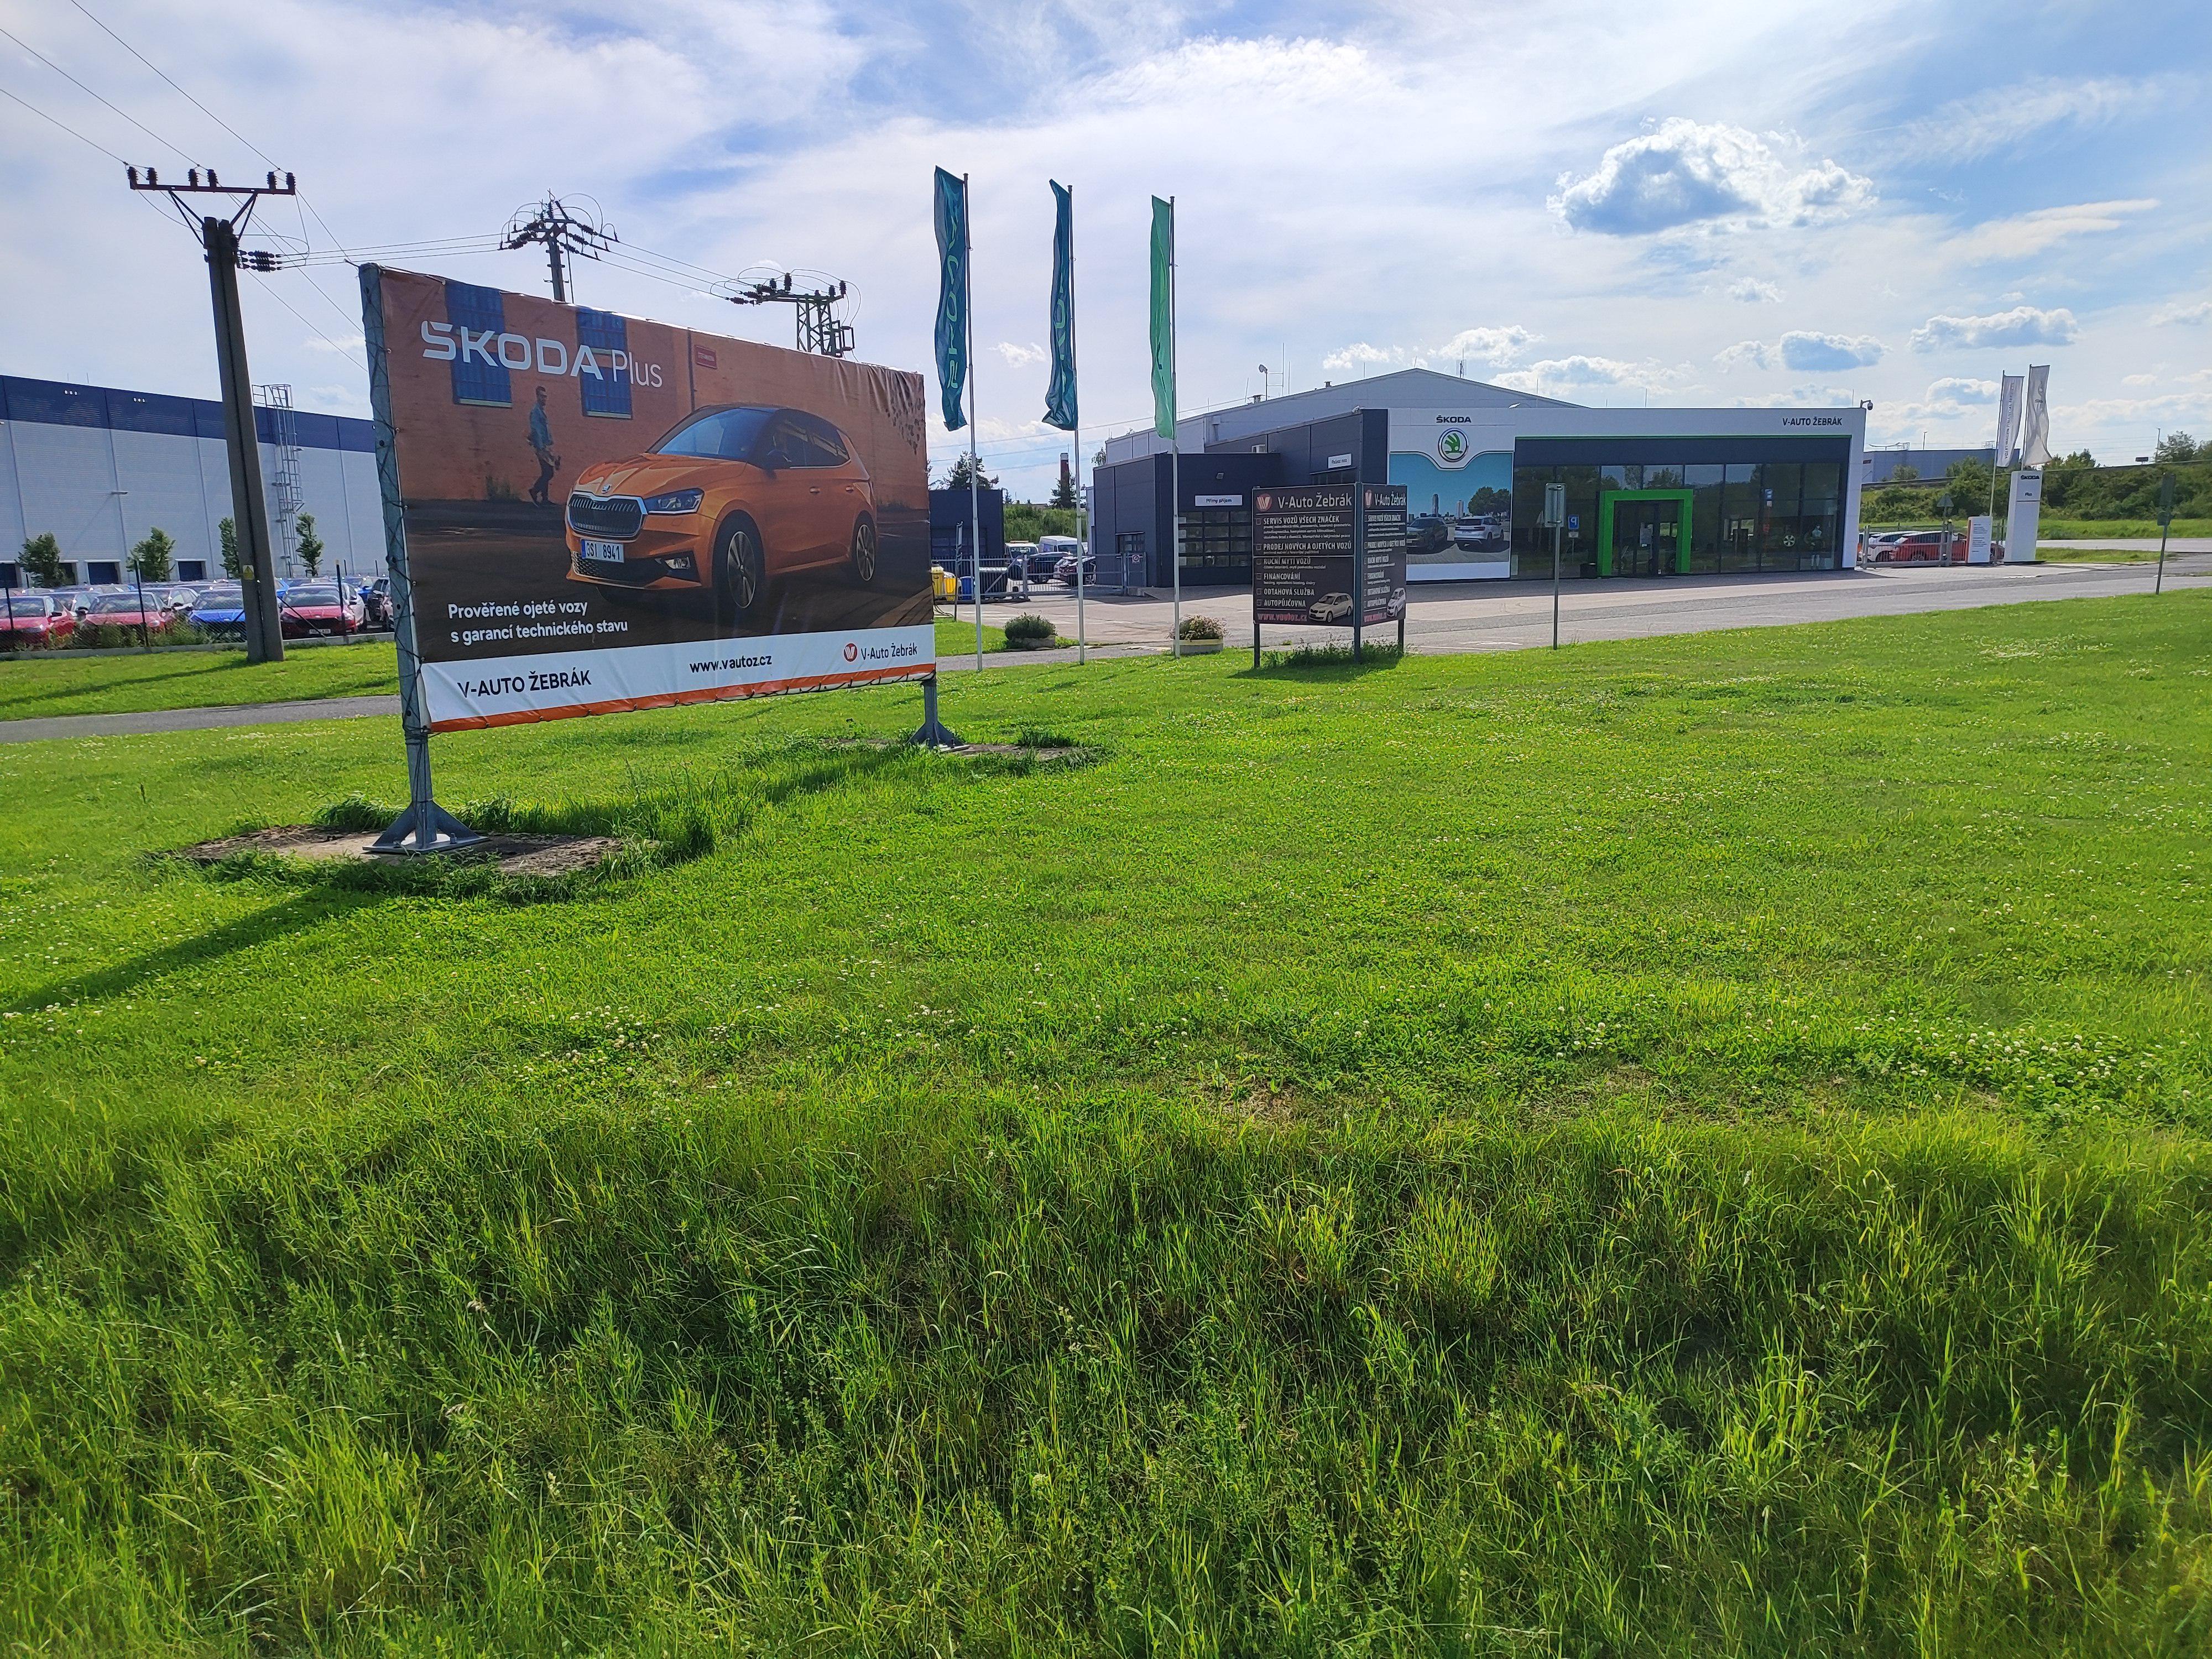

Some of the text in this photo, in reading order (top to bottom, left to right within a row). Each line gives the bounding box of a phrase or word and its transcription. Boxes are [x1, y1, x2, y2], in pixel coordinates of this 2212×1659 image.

[611, 348, 663, 388] Plus
[1436, 415, 1472, 423] ŠKODA
[1782, 416, 1843, 426] V-AUTO ŽEBRÁK
[1277, 492, 1353, 509] V-Auto Žebrák
[1374, 491, 1406, 506] V-Auto Žebrák
[1283, 515, 1298, 524] VOZŮ
[1299, 515, 1317, 524] VŠECH
[1317, 514, 1340, 523] ZNAČEK
[1285, 541, 1306, 550] NOVÝCH
[1312, 541, 1335, 550] OJETÝCH
[1336, 540, 1352, 549] VOZŮ
[1264, 572, 1301, 580] FINANCOVÁNÍ
[1264, 587, 1293, 596] ODTAHOVÁ
[448, 599, 588, 619] Prověřené ojeté vozy
[451, 619, 628, 646] s garancí technického stavu
[891, 643, 918, 658] Žebrák
[689, 655, 773, 673] www.vautoz.cz
[457, 667, 593, 698] V-AUTO ŽEBRÁK
